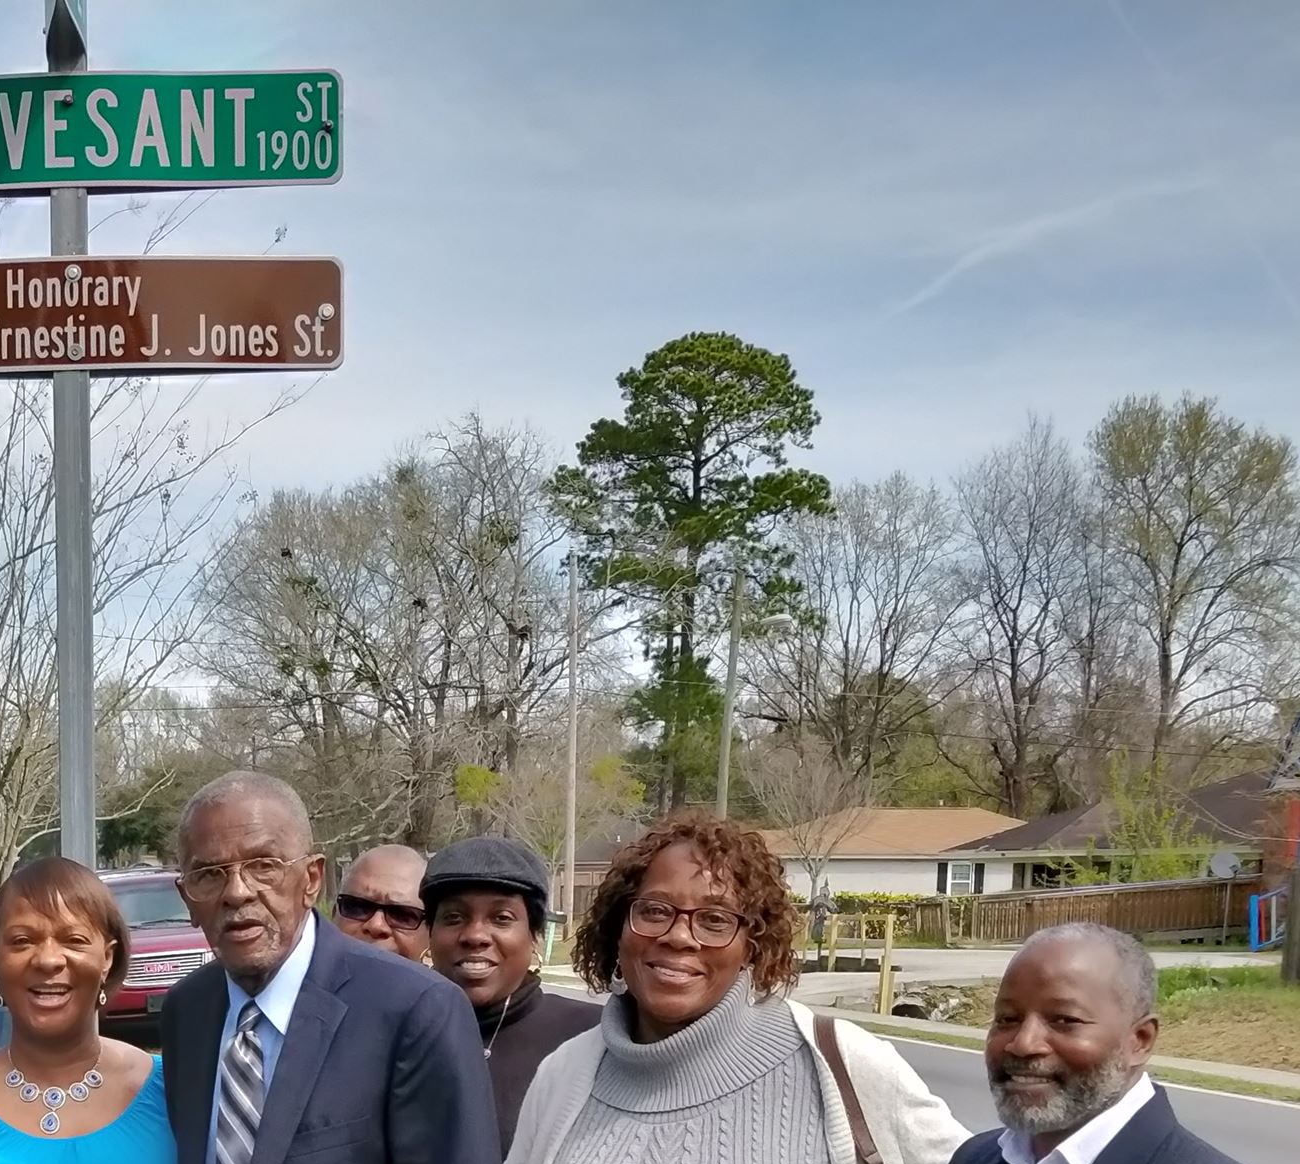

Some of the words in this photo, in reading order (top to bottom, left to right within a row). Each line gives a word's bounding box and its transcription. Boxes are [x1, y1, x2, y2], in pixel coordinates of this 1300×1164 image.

[295, 81, 332, 123] ST
[256, 130, 332, 171] 1900
[6, 268, 142, 316] Honorary
[139, 313, 171, 356] J.
[187, 313, 279, 358] Jones
[293, 313, 334, 358] St.
[143, 961, 181, 975] GMC
